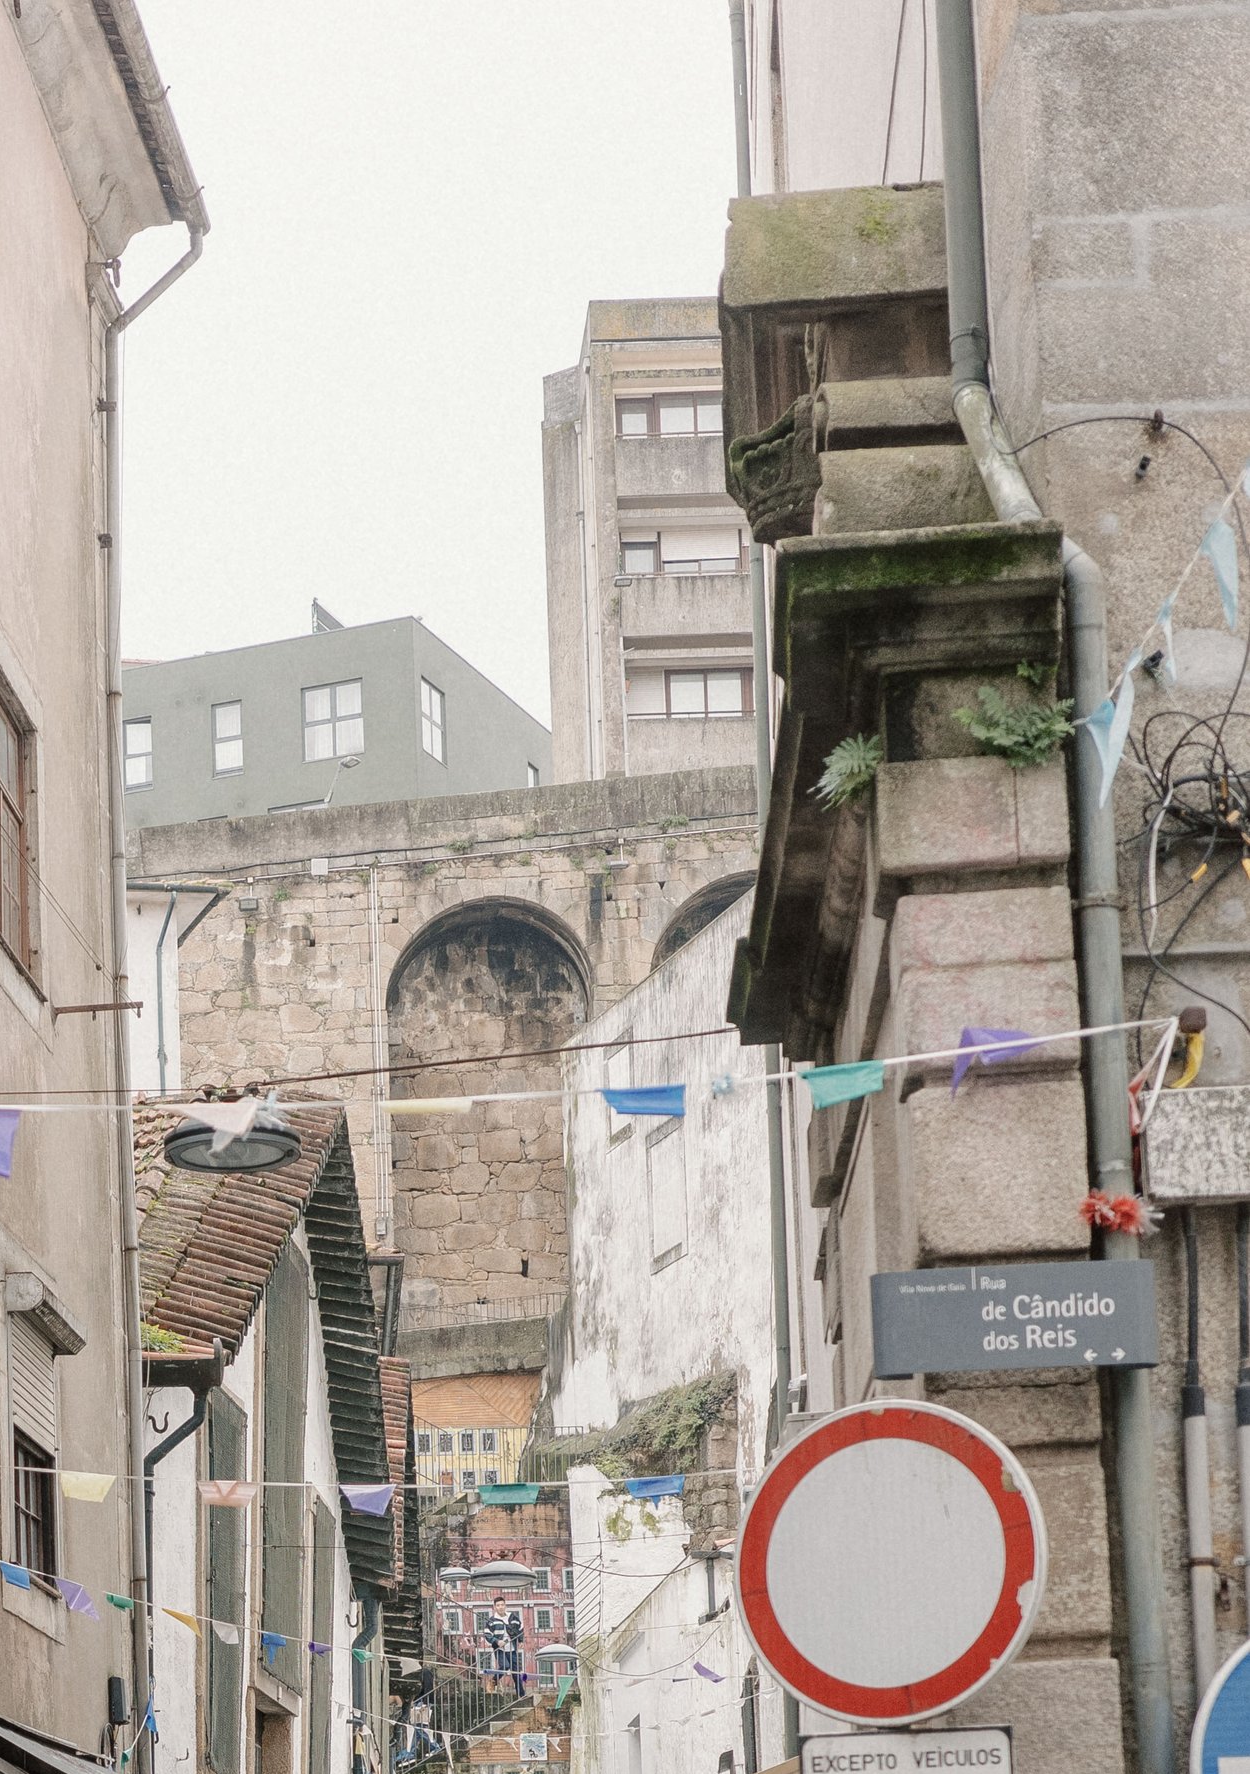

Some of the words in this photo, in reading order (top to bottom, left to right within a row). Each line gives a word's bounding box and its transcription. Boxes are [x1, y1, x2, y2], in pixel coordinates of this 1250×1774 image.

[980, 1276, 1007, 1290] Rua
[981, 1301, 1007, 1321] de
[1012, 1292, 1116, 1319] Cândido
[983, 1331, 1020, 1350] dos
[1025, 1324, 1078, 1349] Reis
[811, 1753, 898, 1773] EXCEPTO
